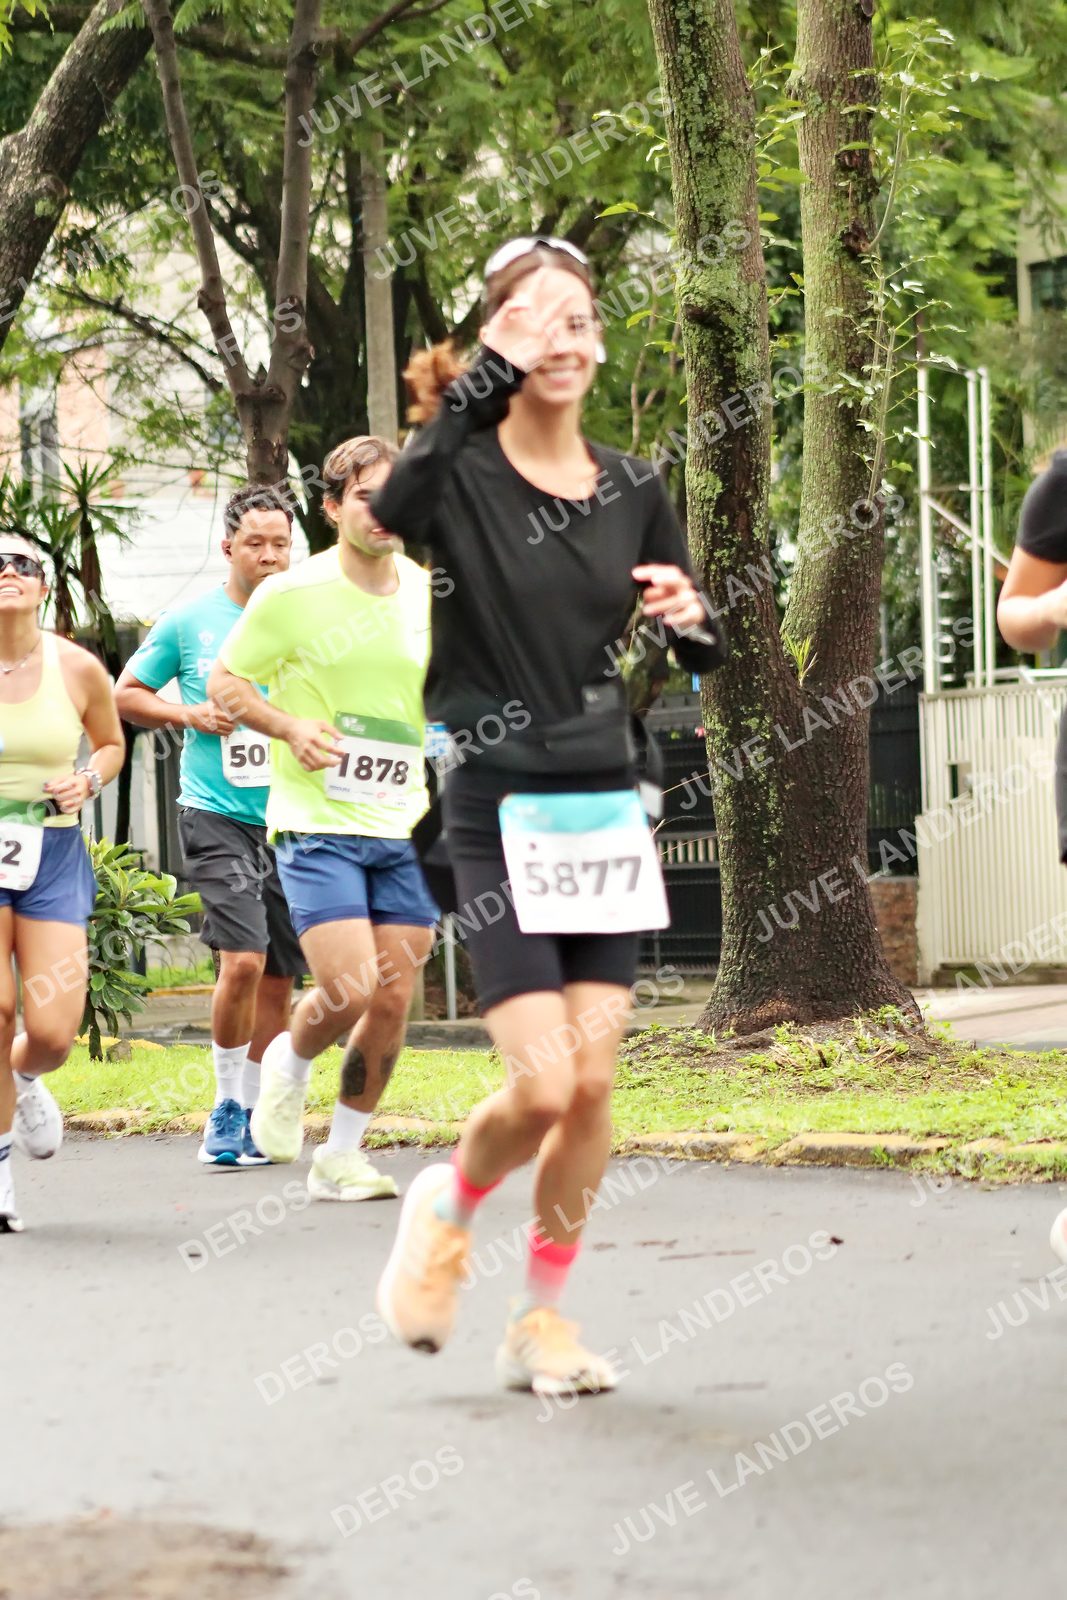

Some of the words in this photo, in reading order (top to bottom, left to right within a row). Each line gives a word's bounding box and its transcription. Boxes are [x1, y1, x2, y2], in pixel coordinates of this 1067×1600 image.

[229, 743, 270, 769] 50
[338, 752, 409, 786] 1878
[0, 838, 22, 867] 2
[524, 855, 642, 897] 5877
